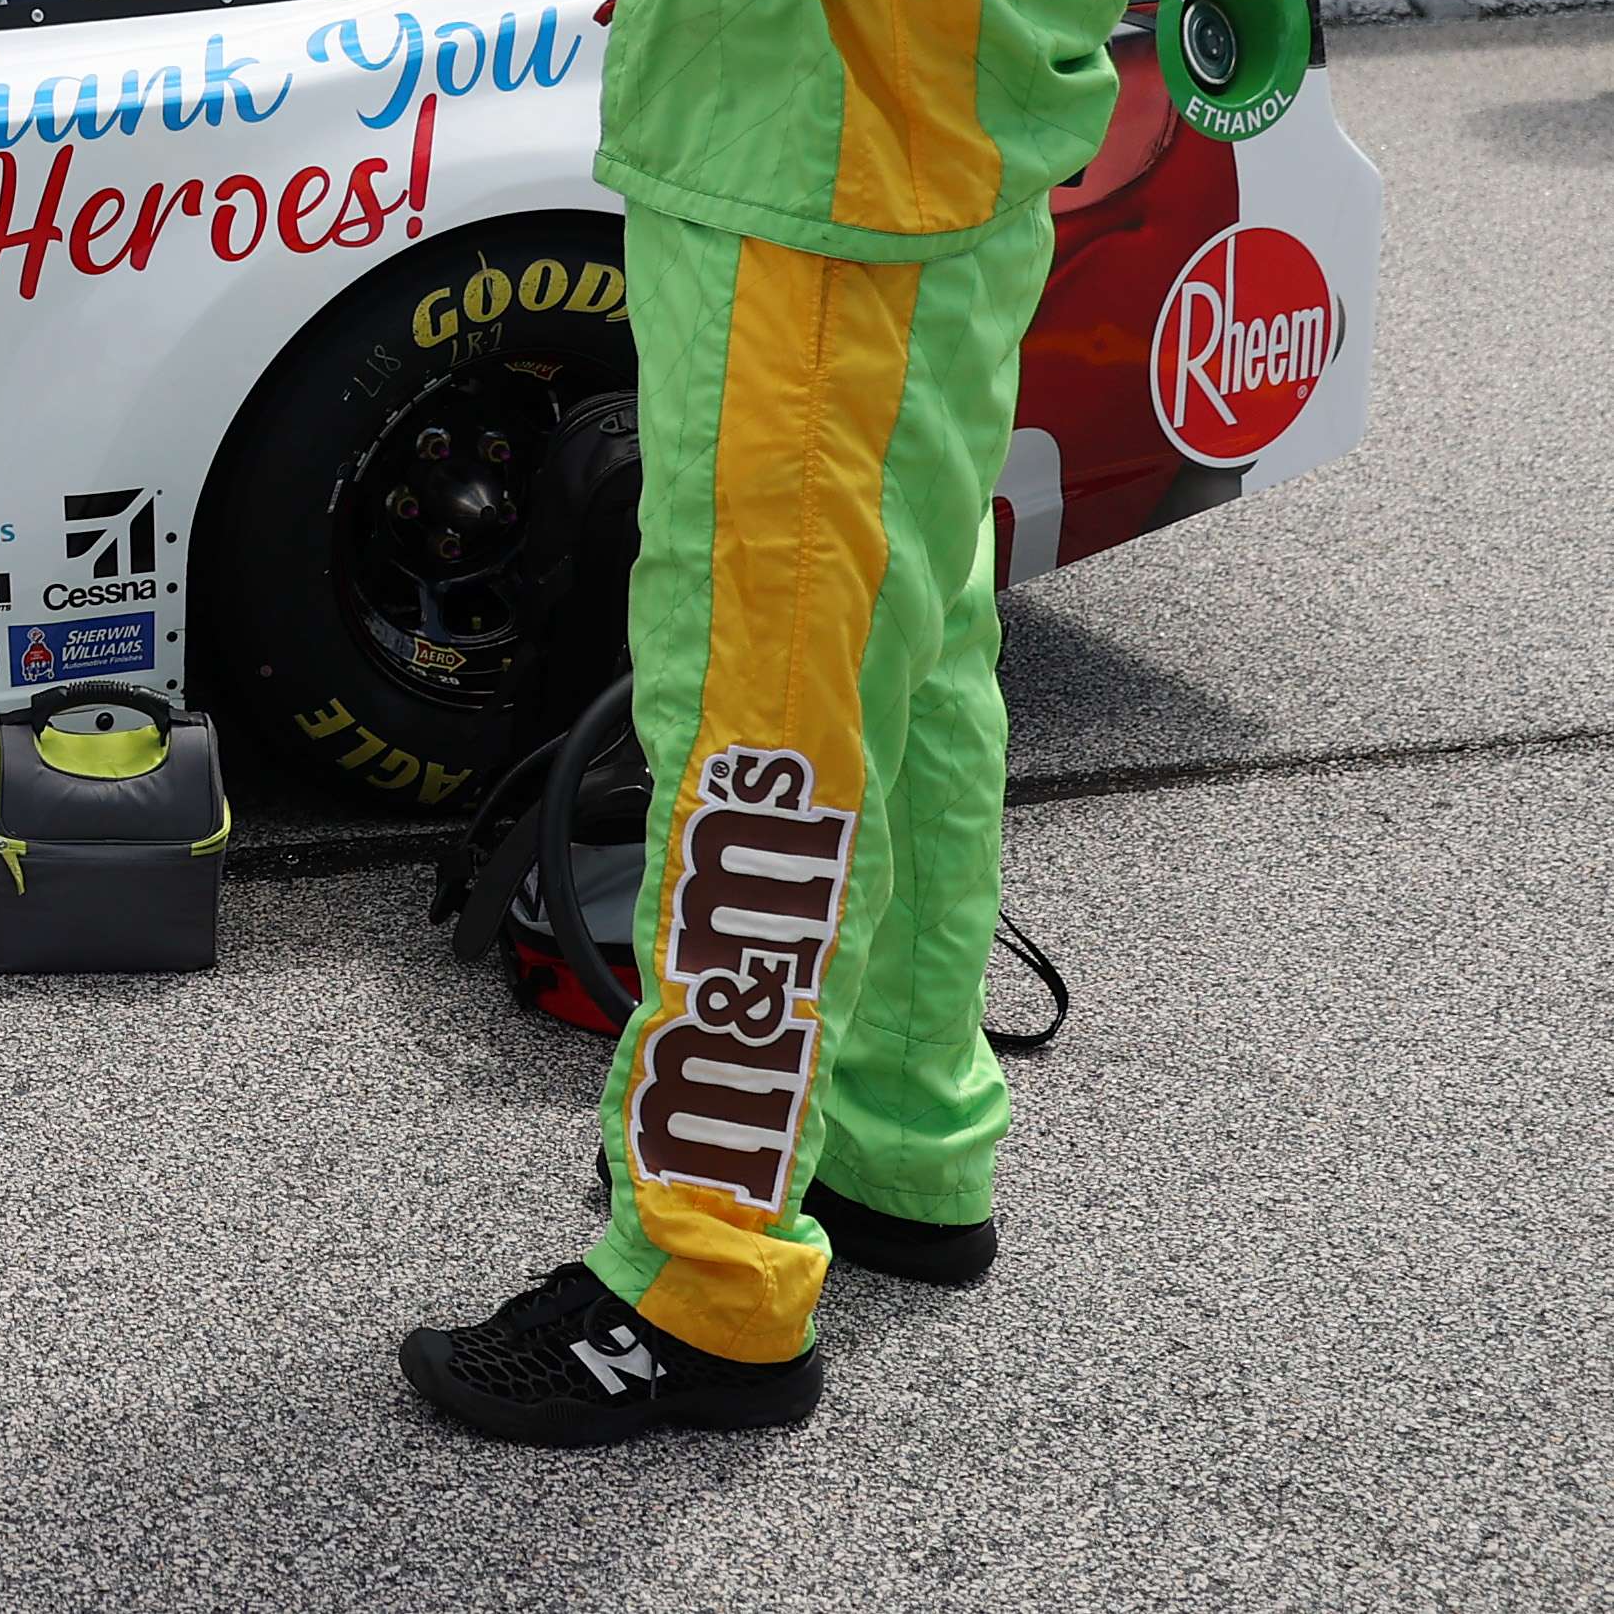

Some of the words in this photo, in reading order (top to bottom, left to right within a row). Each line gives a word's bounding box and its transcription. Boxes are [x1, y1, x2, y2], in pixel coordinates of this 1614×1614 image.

[306, 6, 582, 130] You
[1183, 87, 1294, 136] ETHANOL
[412, 258, 630, 349] GOOD
[1172, 233, 1325, 429] Rheem
[42, 579, 158, 611] Cessna
[62, 639, 143, 662] WILLIAMS
[66, 624, 141, 646] SHERWIN
[62, 659, 109, 670] Automotive
[109, 654, 144, 665] Finishes
[419, 648, 455, 665] AERO
[295, 696, 474, 805] AGLE
